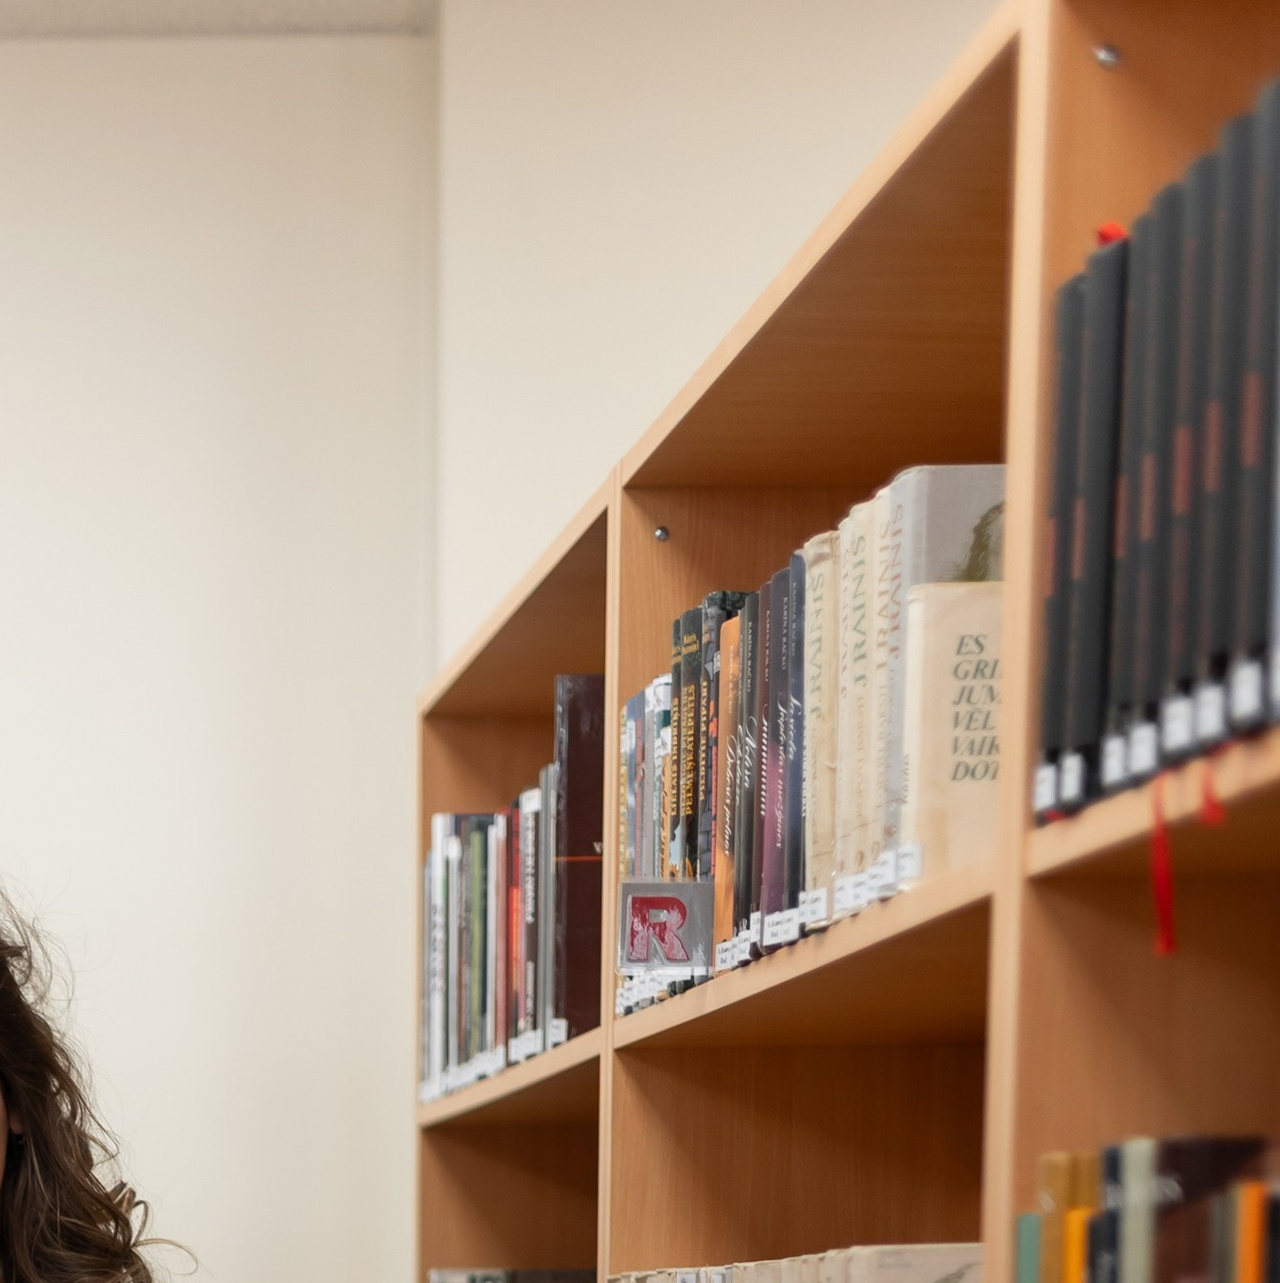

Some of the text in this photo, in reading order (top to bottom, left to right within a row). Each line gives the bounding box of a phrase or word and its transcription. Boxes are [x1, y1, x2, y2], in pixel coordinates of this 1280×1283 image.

[955, 634, 987, 656] ES
[953, 659, 1001, 681] GRI
[952, 707, 996, 730] VĒL
[628, 896, 688, 962] R
